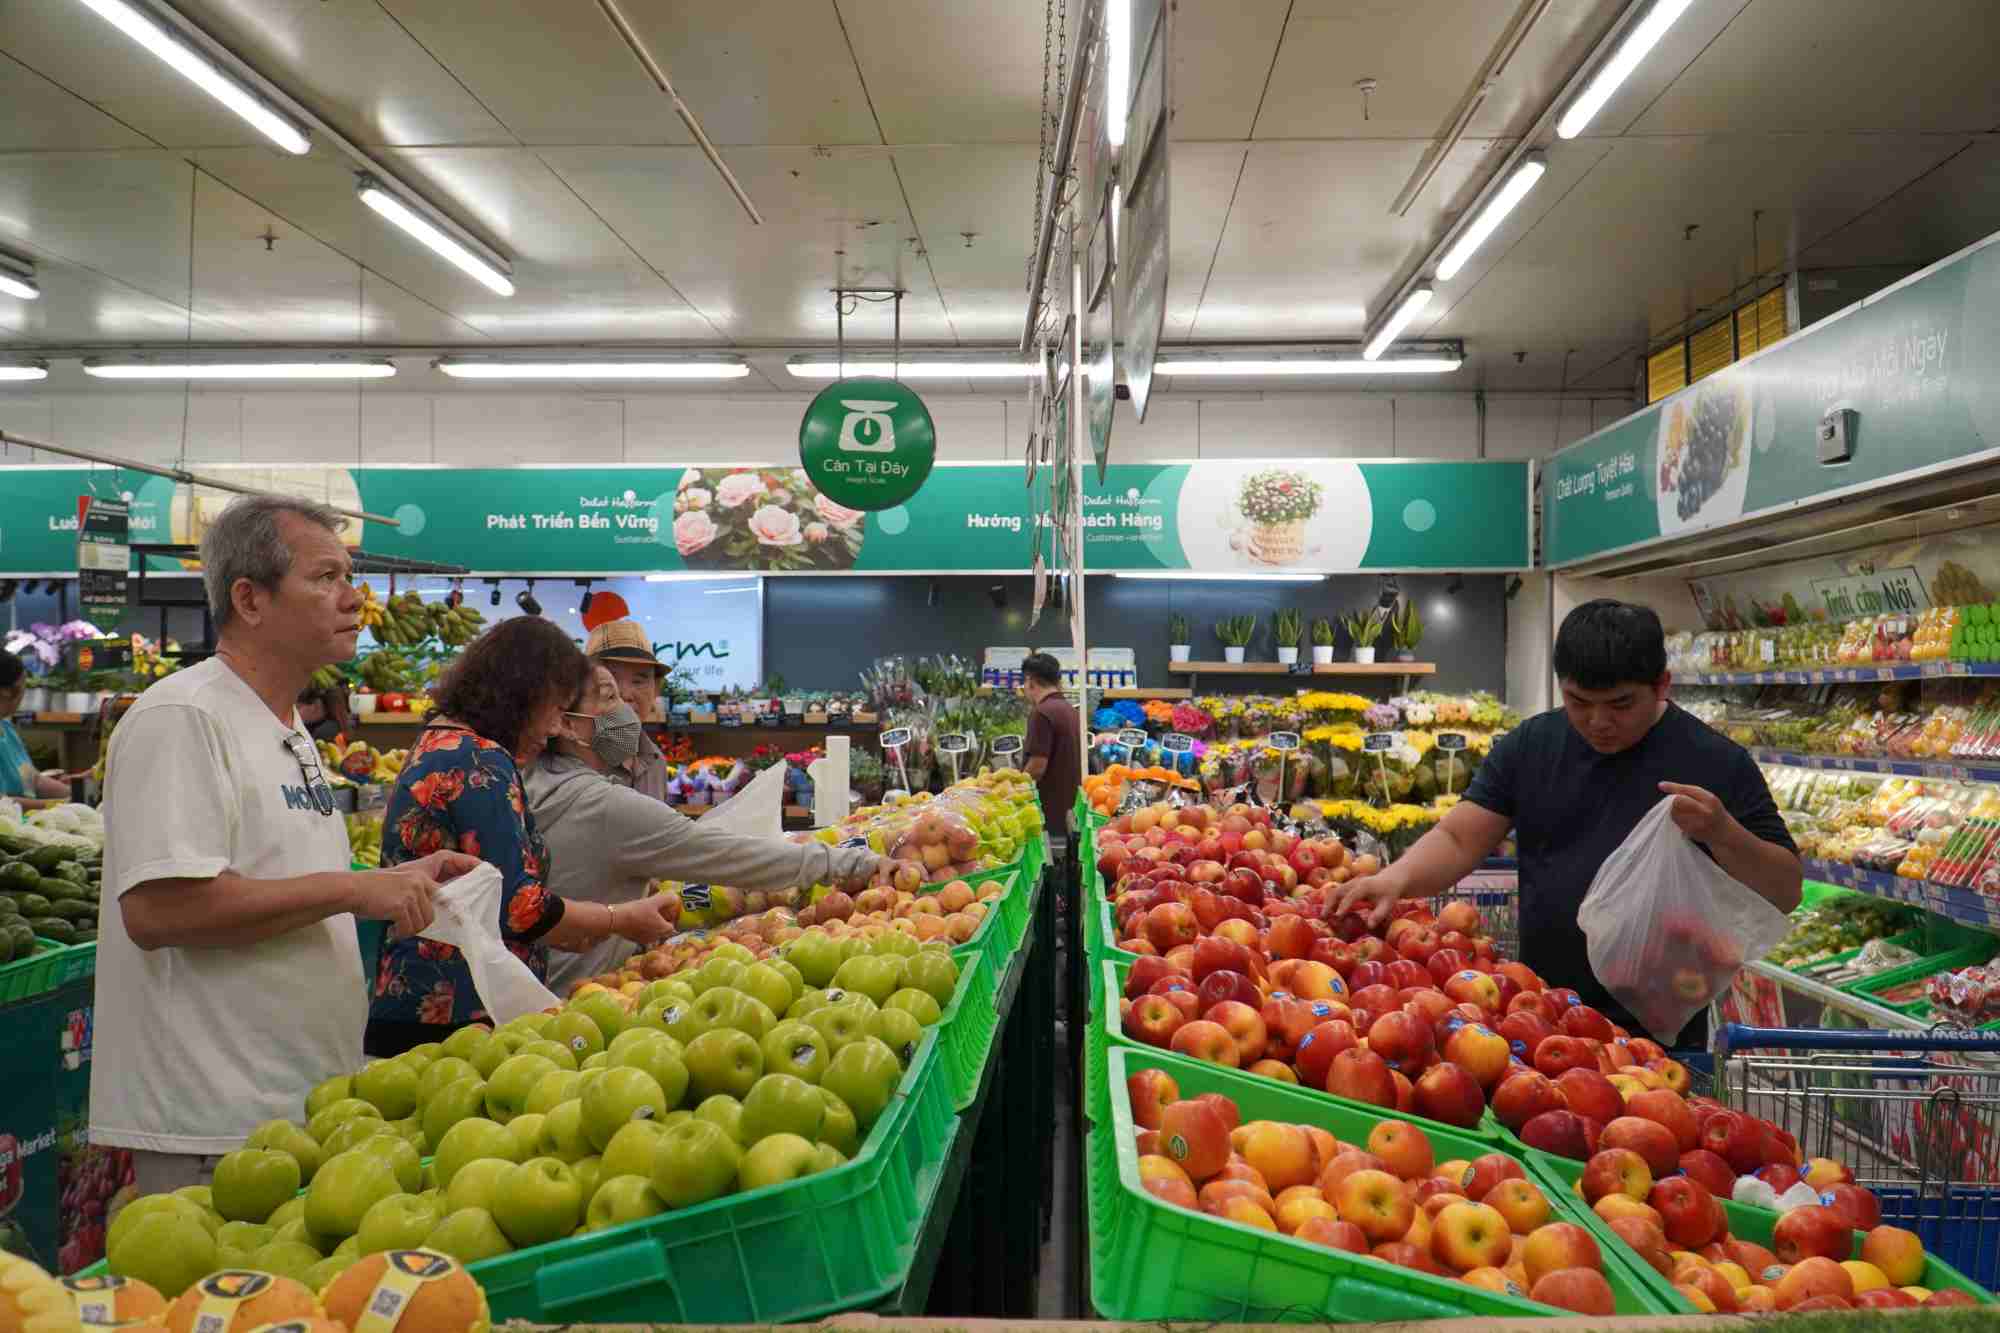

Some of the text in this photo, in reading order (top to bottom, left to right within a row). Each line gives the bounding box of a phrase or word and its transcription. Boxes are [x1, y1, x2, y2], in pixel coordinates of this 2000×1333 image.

[823, 459, 850, 472] Cân
[880, 461, 909, 478] Đây
[487, 510, 659, 532] Phát Triển Bền Vững
[967, 512, 1021, 532] Hướng
[1121, 510, 1163, 530] Hàng
